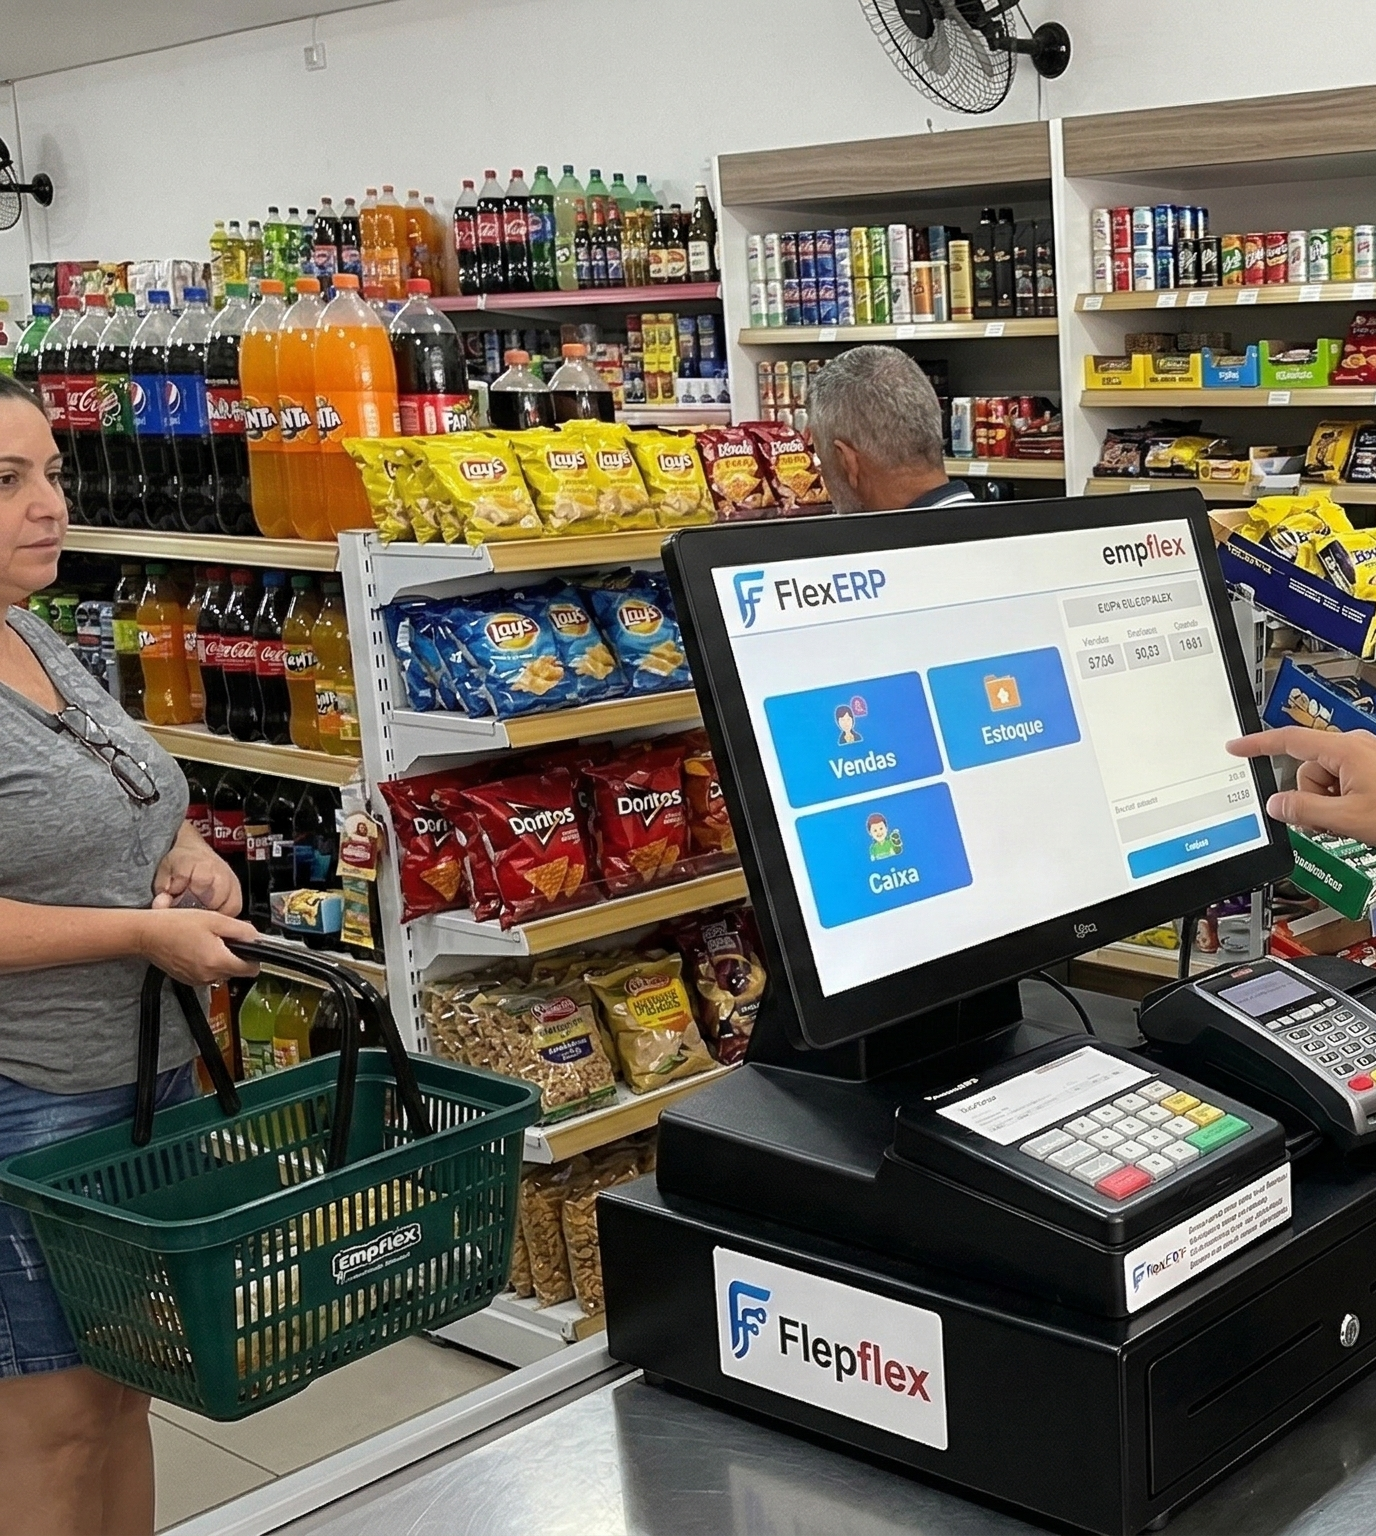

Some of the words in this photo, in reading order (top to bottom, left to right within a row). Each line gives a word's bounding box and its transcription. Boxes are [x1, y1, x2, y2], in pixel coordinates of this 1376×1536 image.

[1102, 534, 1186, 567] empflex
[774, 569, 886, 611] FlexERP
[982, 719, 1043, 745] Estoque
[829, 751, 897, 779] Vendas
[617, 788, 682, 815] Doritos
[508, 806, 575, 836] Doritos
[869, 867, 920, 894] Caixa
[779, 1315, 931, 1402] Flepflex
